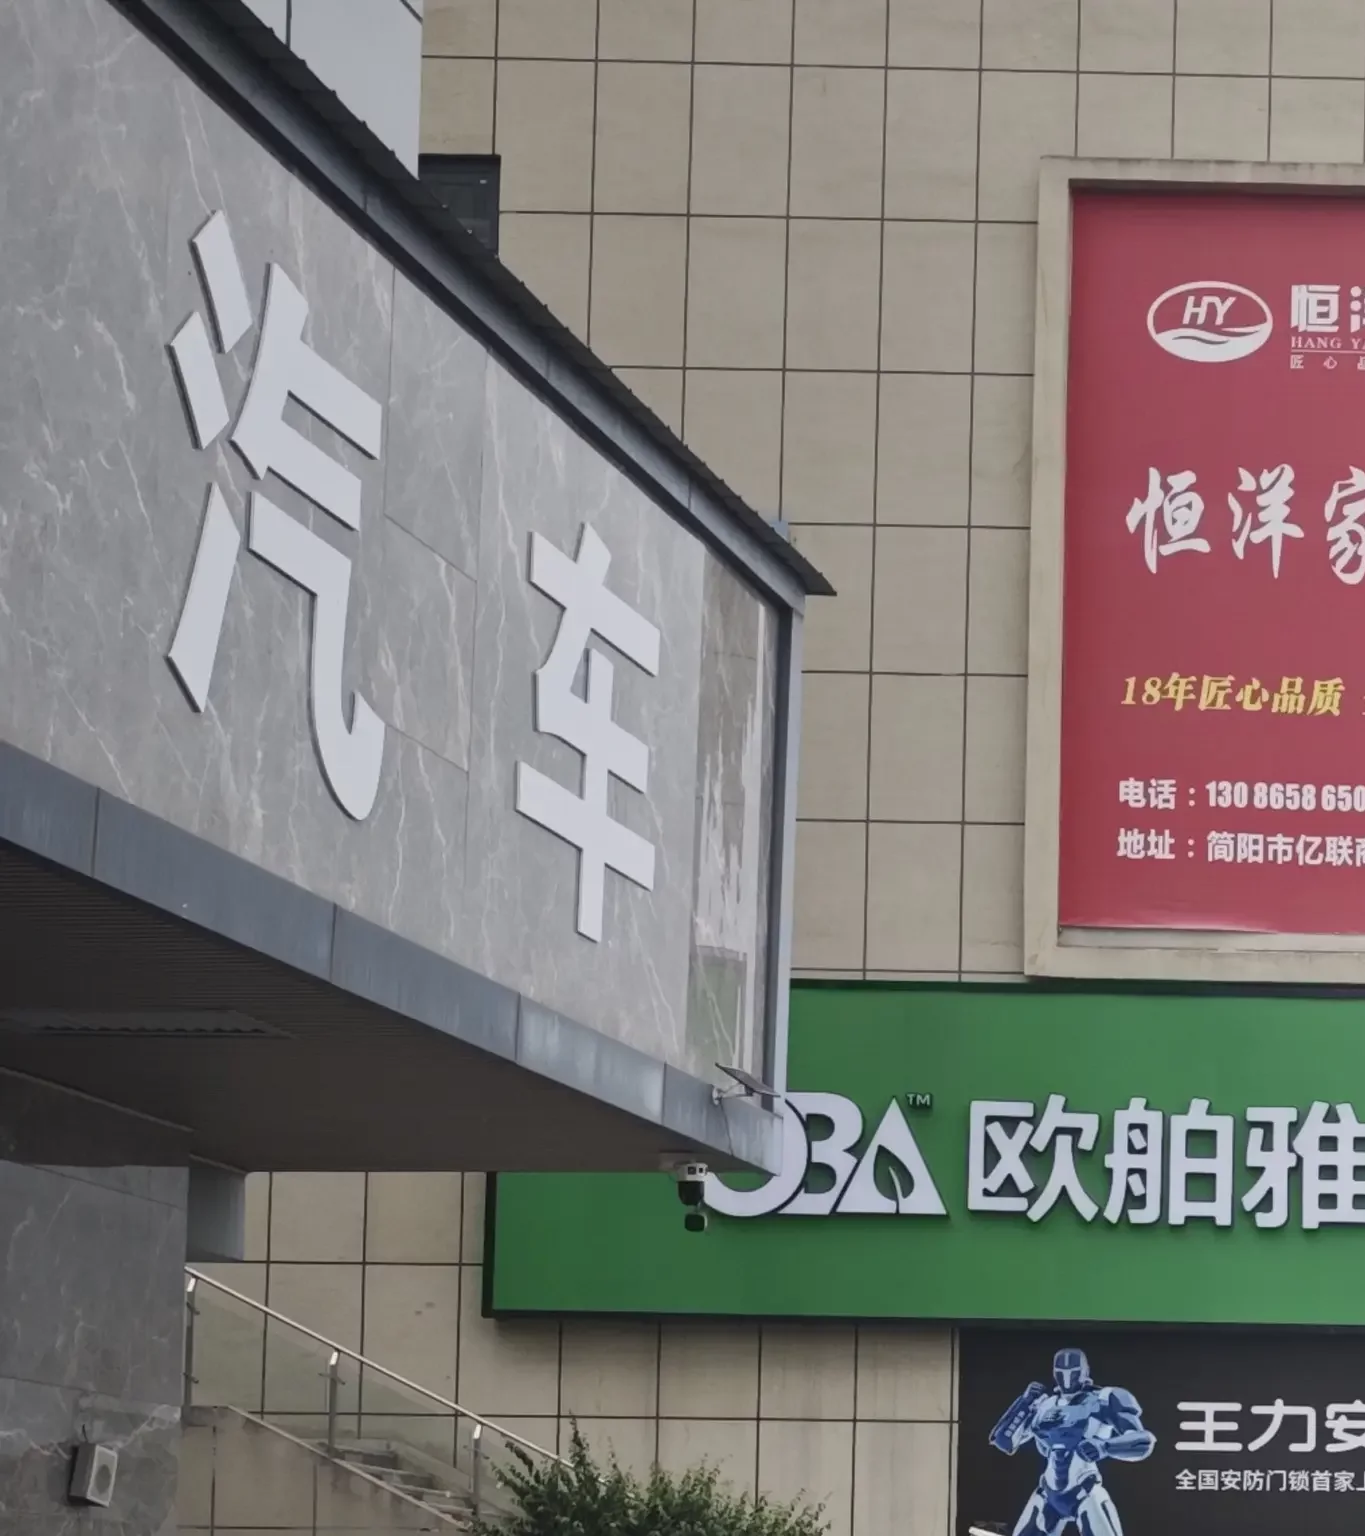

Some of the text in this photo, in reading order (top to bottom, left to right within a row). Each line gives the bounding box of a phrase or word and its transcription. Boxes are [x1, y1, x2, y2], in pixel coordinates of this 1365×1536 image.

[1182, 296, 1236, 325] HY
[1291, 336, 1342, 350] HANG
[165, 210, 662, 943] 汽车
[1121, 672, 1345, 717] 18年匠心品质
